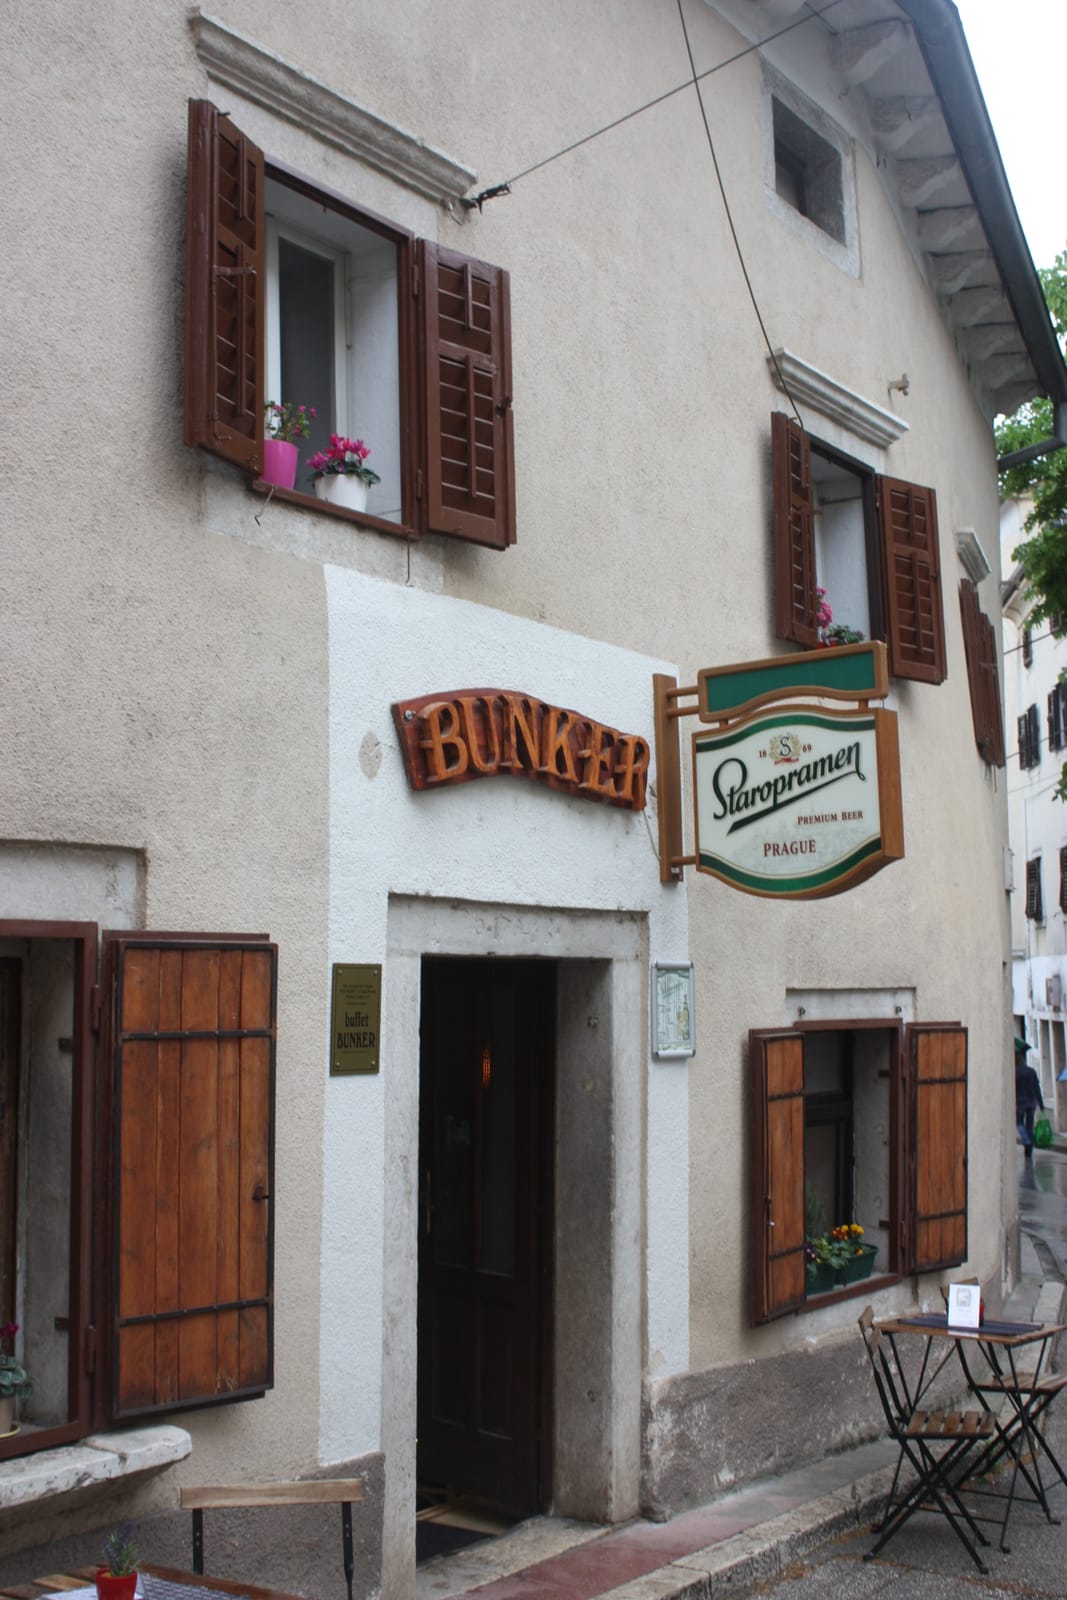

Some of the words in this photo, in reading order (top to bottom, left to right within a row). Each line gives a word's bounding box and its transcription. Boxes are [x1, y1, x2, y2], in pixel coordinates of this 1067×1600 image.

[419, 695, 650, 809] BUNKER
[759, 749, 767, 759] 18
[802, 743, 812, 753] 69
[712, 741, 866, 824] Staropramen
[763, 839, 817, 857] PRAGUE
[337, 1032, 375, 1049] BUNKER
